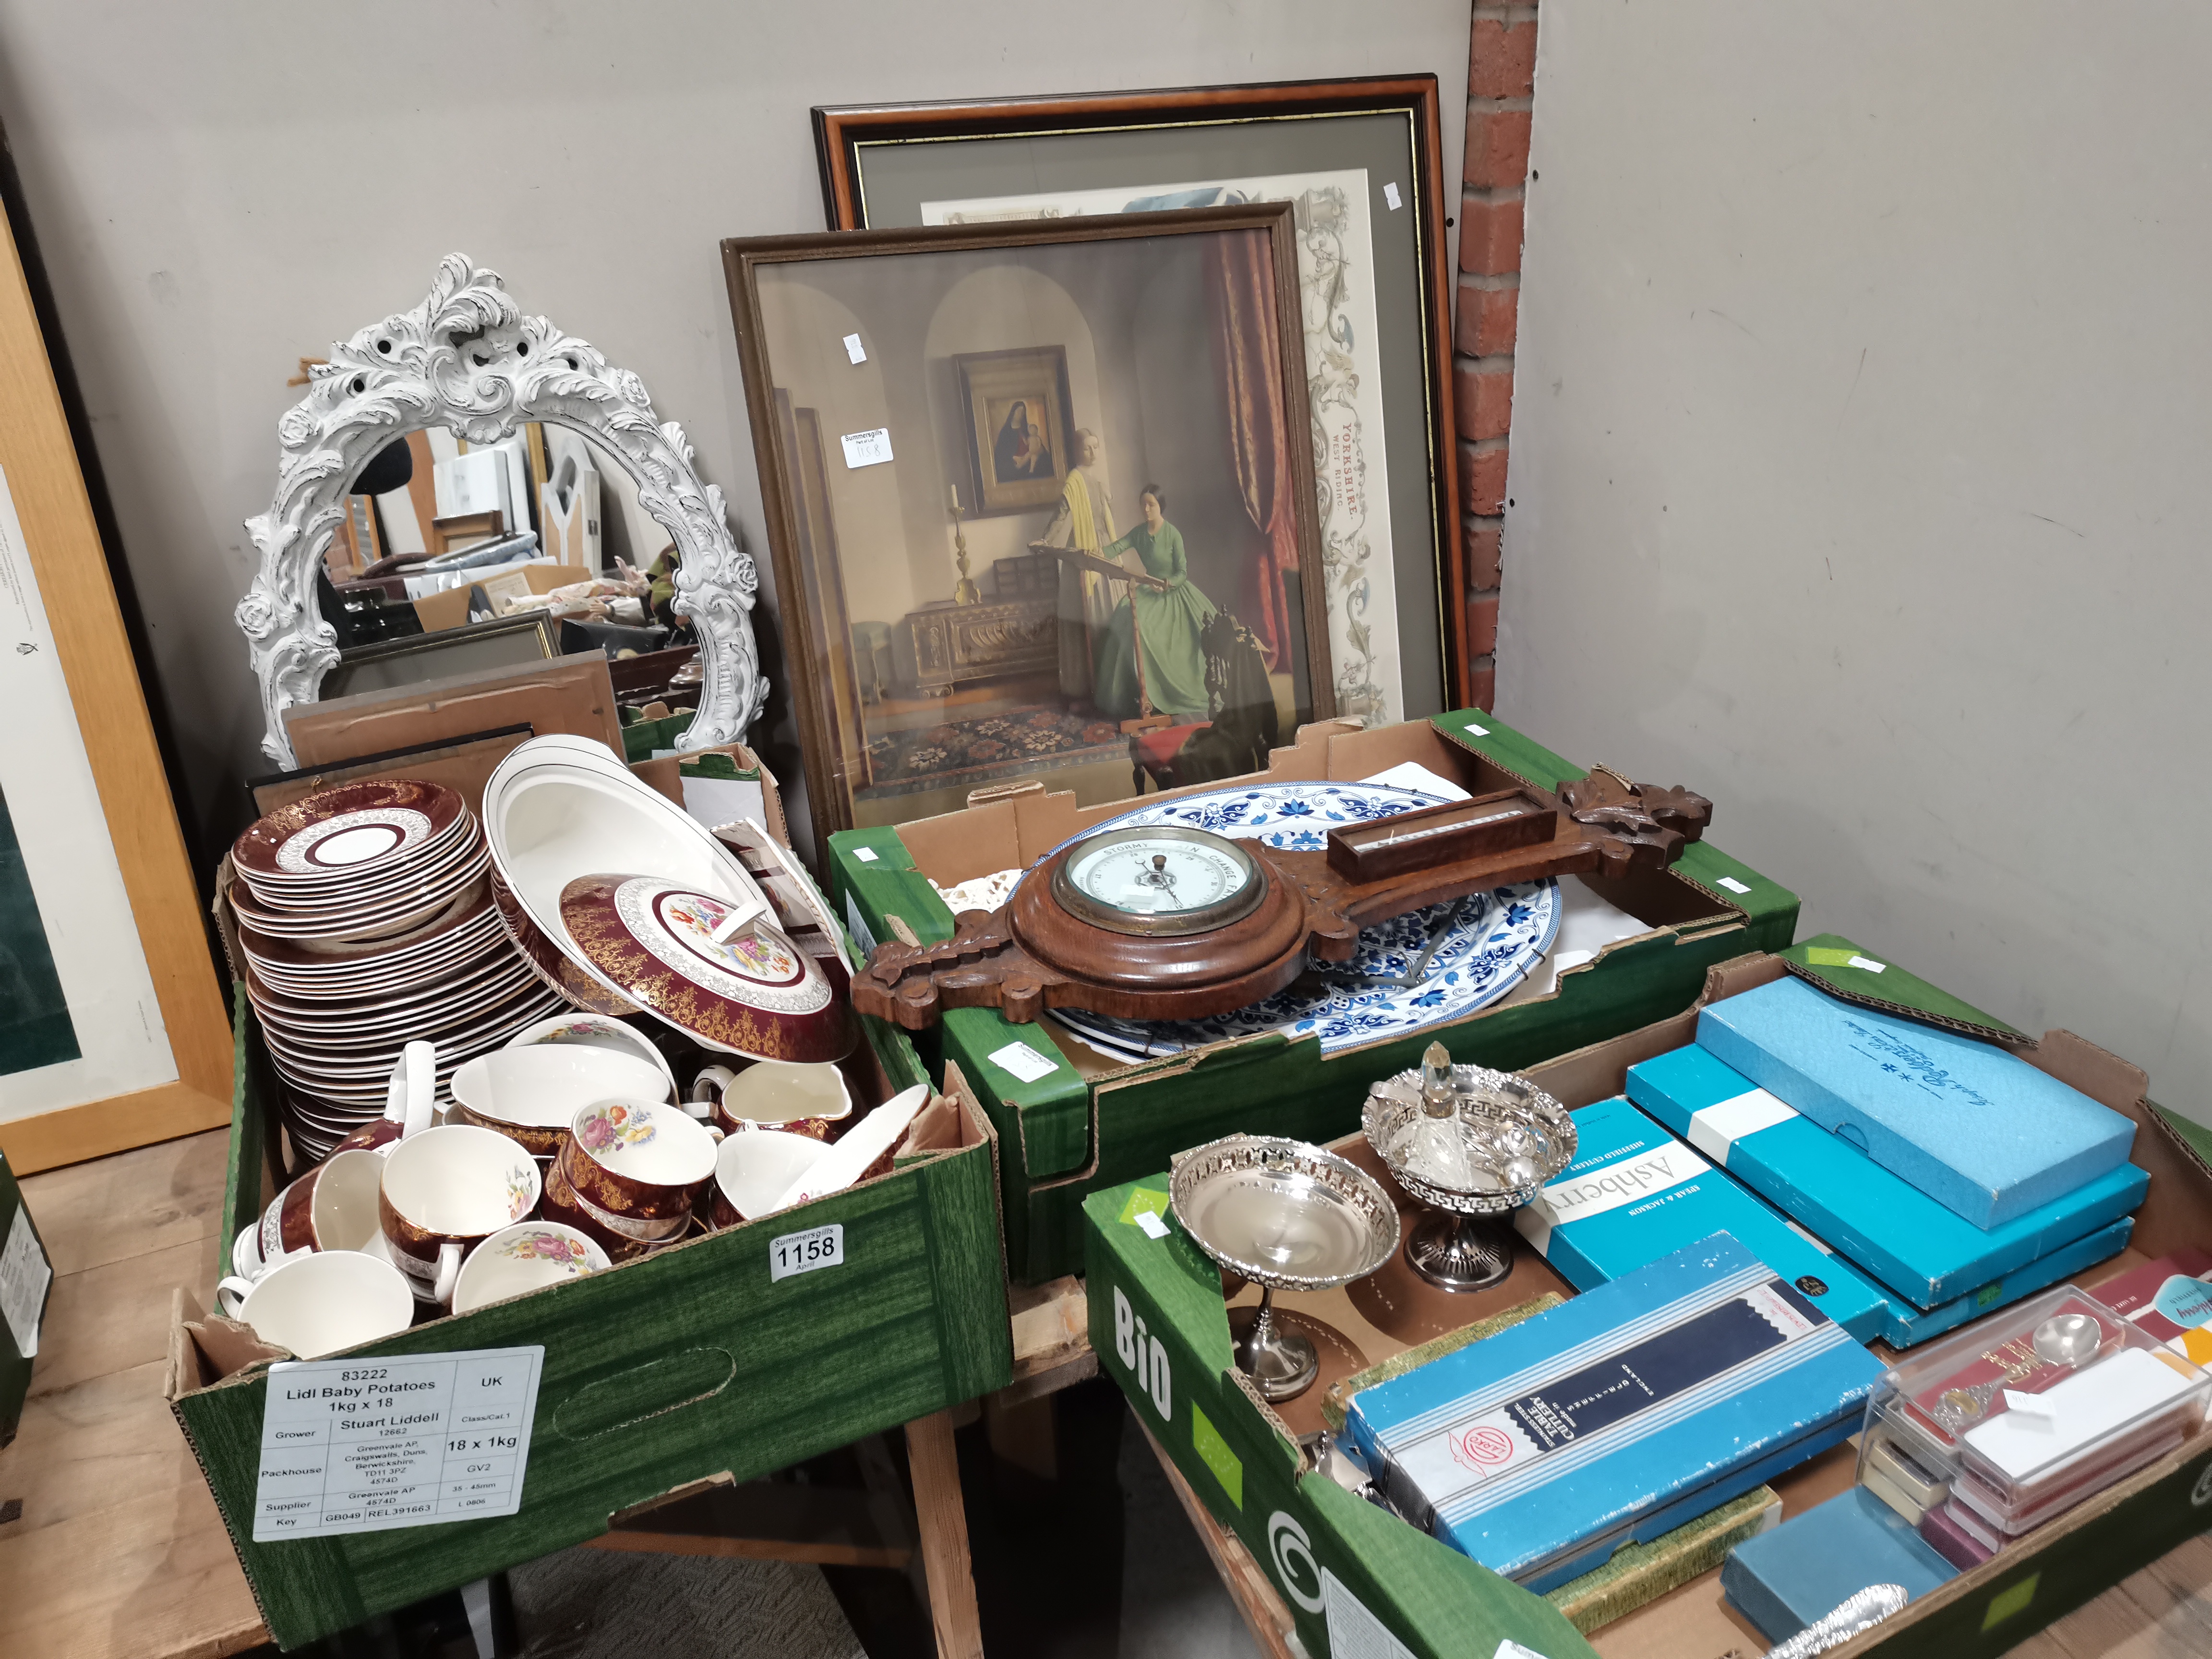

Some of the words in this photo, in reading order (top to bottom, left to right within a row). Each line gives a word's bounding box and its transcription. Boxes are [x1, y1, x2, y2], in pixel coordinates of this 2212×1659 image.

[845, 430, 882, 442] Summersgills
[1104, 843, 1148, 855] STORMY
[1209, 855, 1237, 879] CHANGE
[1018, 1044, 1053, 1066] Summersgills
[1604, 1141, 1645, 1159] SHEFFIELD
[1570, 1156, 1604, 1171] CUTLERY
[1541, 1156, 1674, 1213] Ashberry
[1674, 1185, 1701, 1202] SPEAR
[1628, 1200, 1665, 1217] JACKSON
[775, 1227, 834, 1247] Summersgills
[778, 1237, 834, 1267] 1158
[796, 1261, 815, 1271] April
[341, 1369, 388, 1381] 83222
[481, 1376, 503, 1387] UK
[1621, 1364, 1655, 1396] ENGLAND
[287, 1388, 316, 1400] Lidl
[322, 1387, 362, 1398] Baby
[368, 1382, 436, 1395] Potatoes
[1566, 1379, 1630, 1412] SHEFFIELD
[330, 1401, 356, 1413] 1kg
[377, 1398, 393, 1407] 18
[1514, 1402, 1531, 1421] STEEL
[341, 1418, 385, 1430] Stuart
[391, 1413, 439, 1426] Liddell
[1527, 1406, 1558, 1438] TABLE
[1529, 1396, 1575, 1441] CUTLERY
[276, 1431, 316, 1439] Grower
[1528, 1419, 1556, 1448] STAINLESS
[357, 1443, 403, 1452] Greenvale
[448, 1440, 467, 1451] 18
[472, 1441, 481, 1449] x
[488, 1436, 517, 1448] 1kg
[262, 1467, 322, 1477] Packhouse
[467, 1464, 491, 1472] GV2
[349, 1490, 399, 1499] Greenvale
[266, 1502, 312, 1512] Supplier
[276, 1518, 298, 1527] Key
[325, 1513, 361, 1522] GB049
